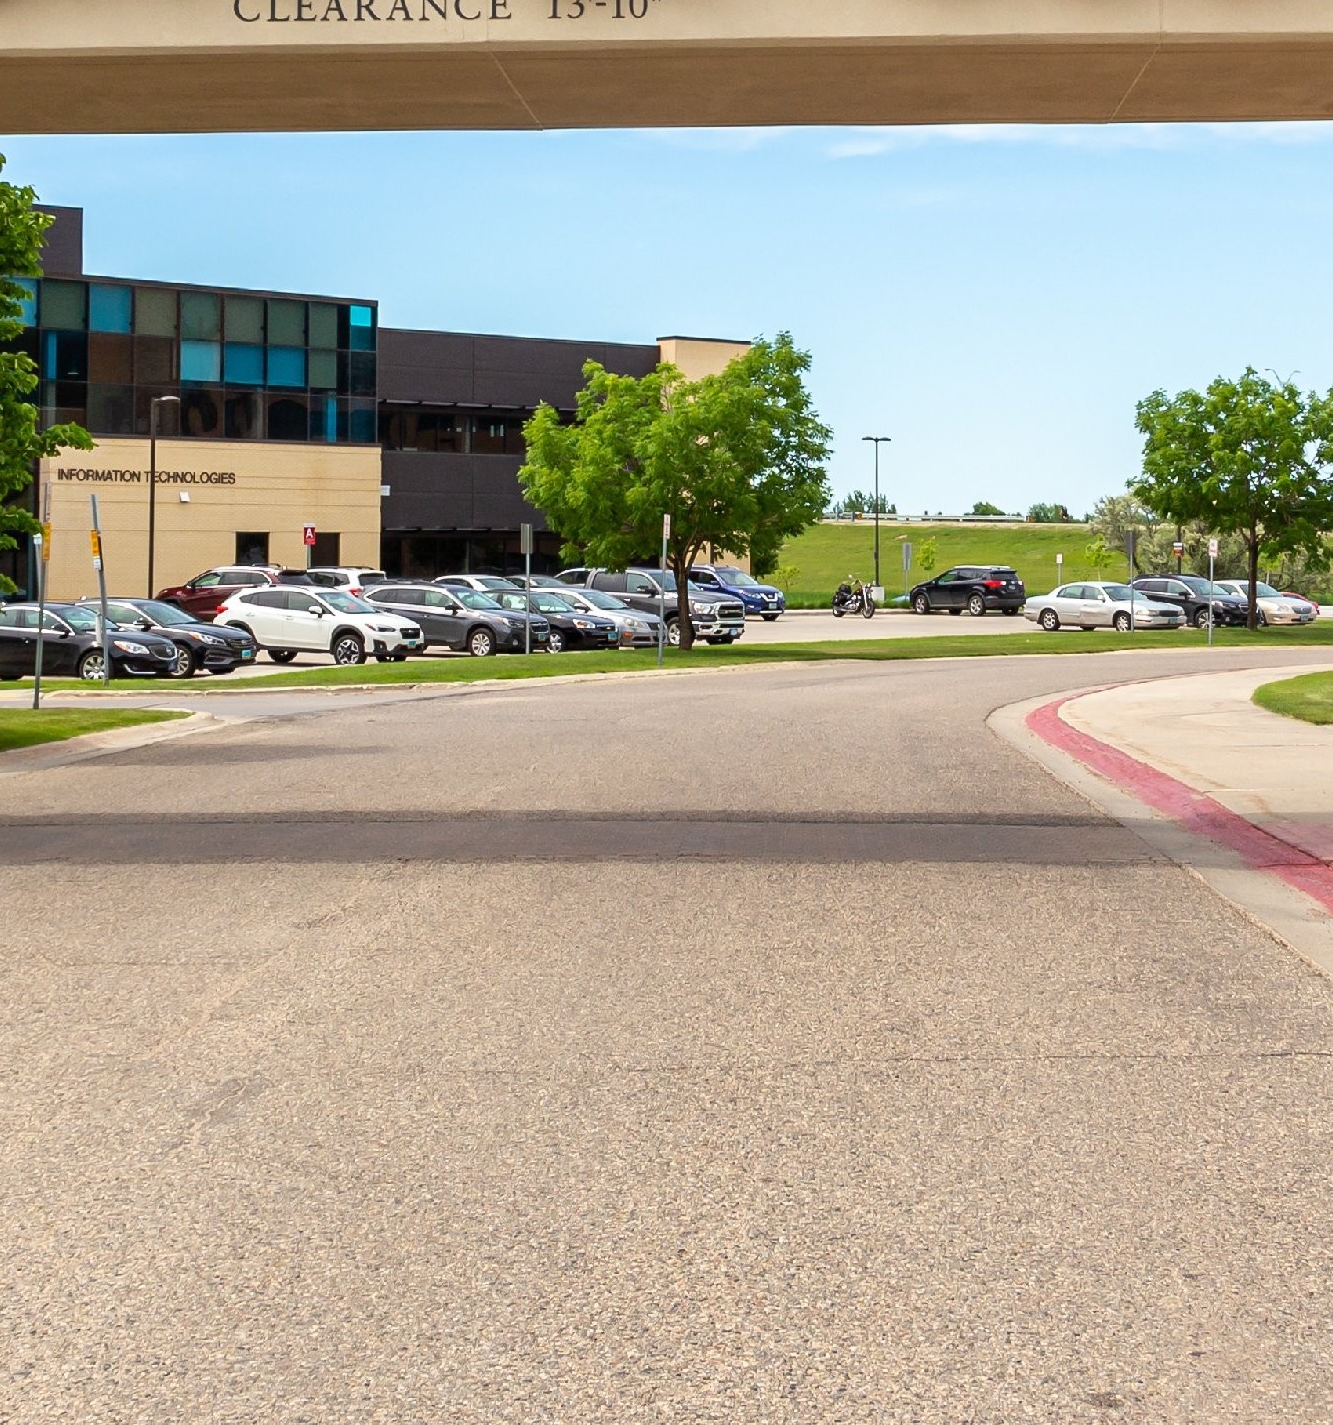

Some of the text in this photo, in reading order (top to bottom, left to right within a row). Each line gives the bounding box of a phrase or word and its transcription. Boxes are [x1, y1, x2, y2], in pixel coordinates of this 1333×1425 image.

[57, 468, 236, 485] INFORMATION TECHNOLOGIES
[305, 527, 314, 539] A
